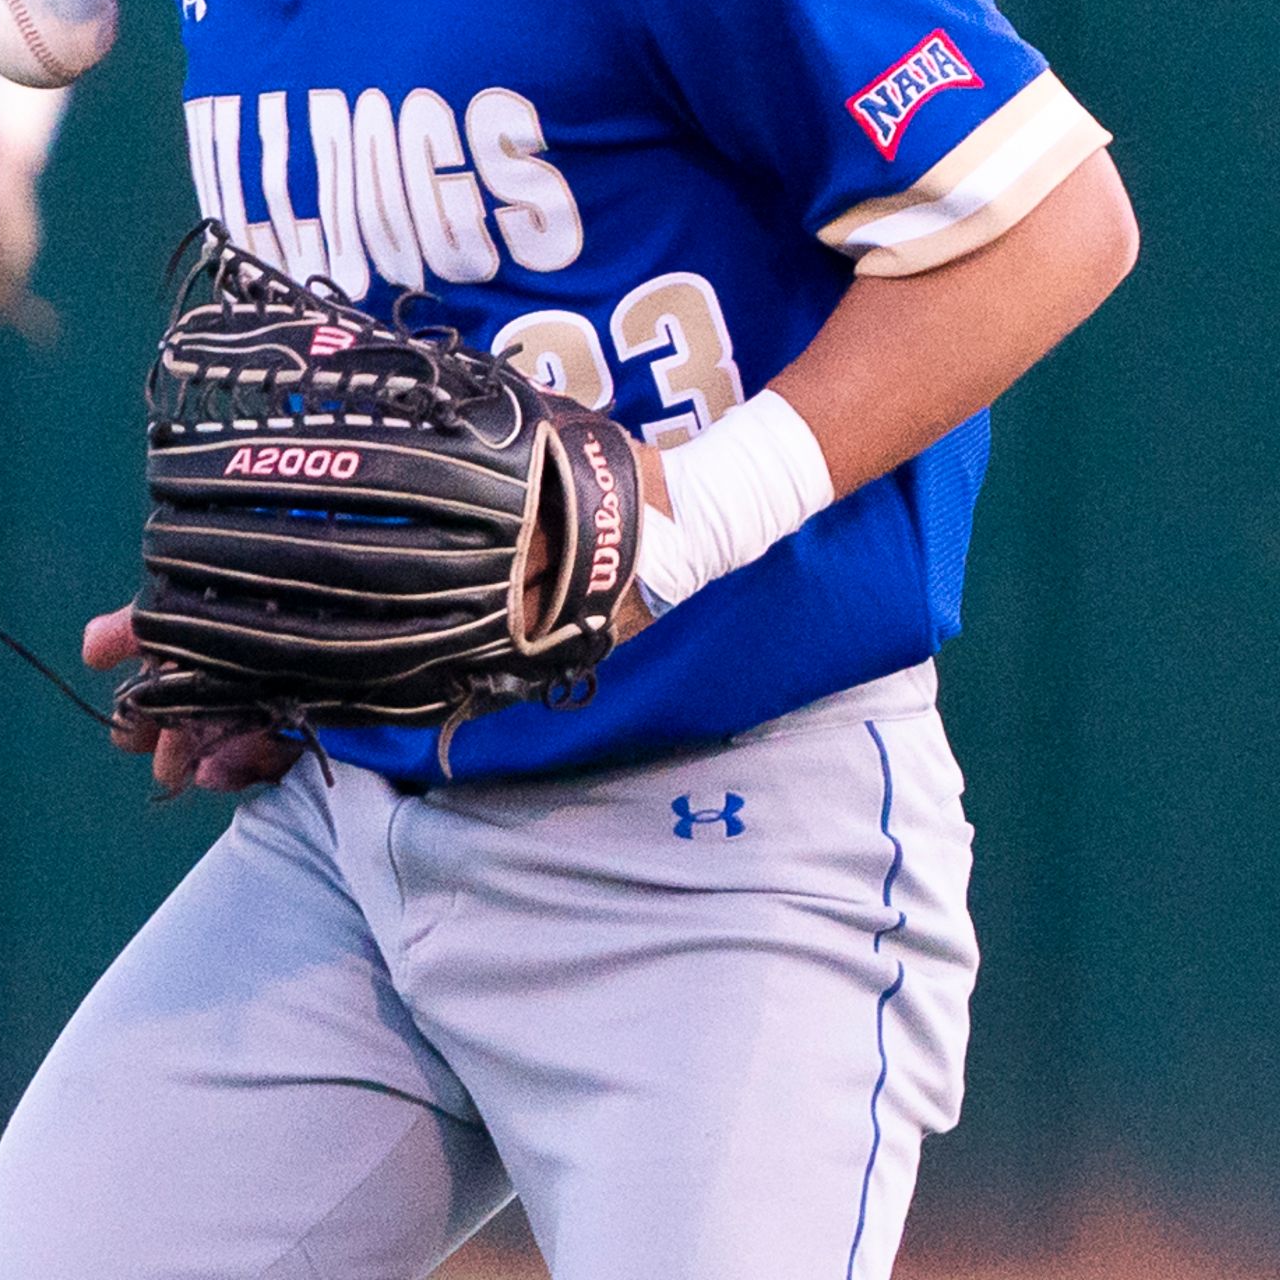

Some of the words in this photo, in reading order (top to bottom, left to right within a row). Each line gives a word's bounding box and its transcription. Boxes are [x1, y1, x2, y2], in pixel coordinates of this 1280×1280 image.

[856, 39, 971, 144] NAIA
[223, 447, 360, 480] A2000
[584, 432, 622, 596] Wilson
